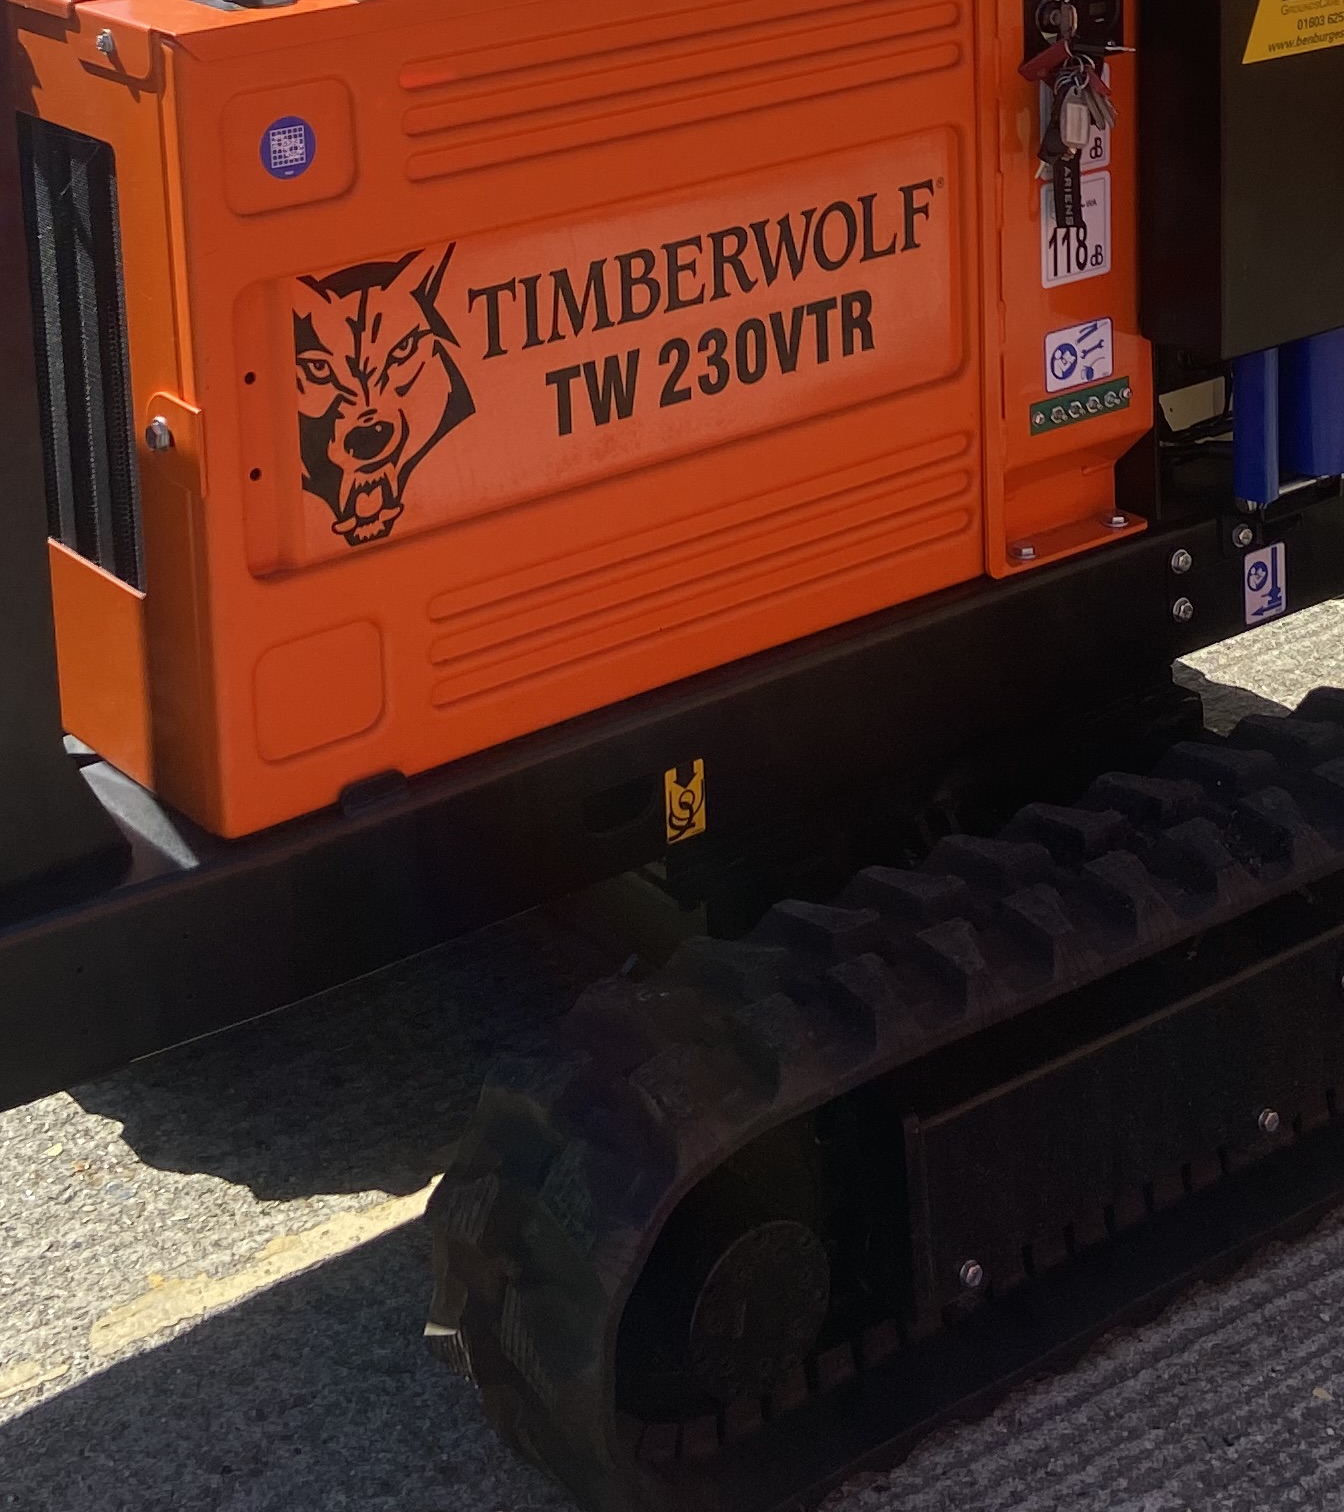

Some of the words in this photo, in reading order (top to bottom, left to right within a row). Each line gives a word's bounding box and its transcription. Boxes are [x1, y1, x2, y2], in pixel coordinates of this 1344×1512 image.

[1297, 14, 1325, 30] 01603
[1062, 166, 1075, 227] ARIENS
[467, 178, 934, 360] TIMBERWOLF
[1048, 220, 1088, 277] 118
[1090, 243, 1104, 268] dB
[546, 349, 641, 436] TW
[659, 290, 876, 408] 230VTR
